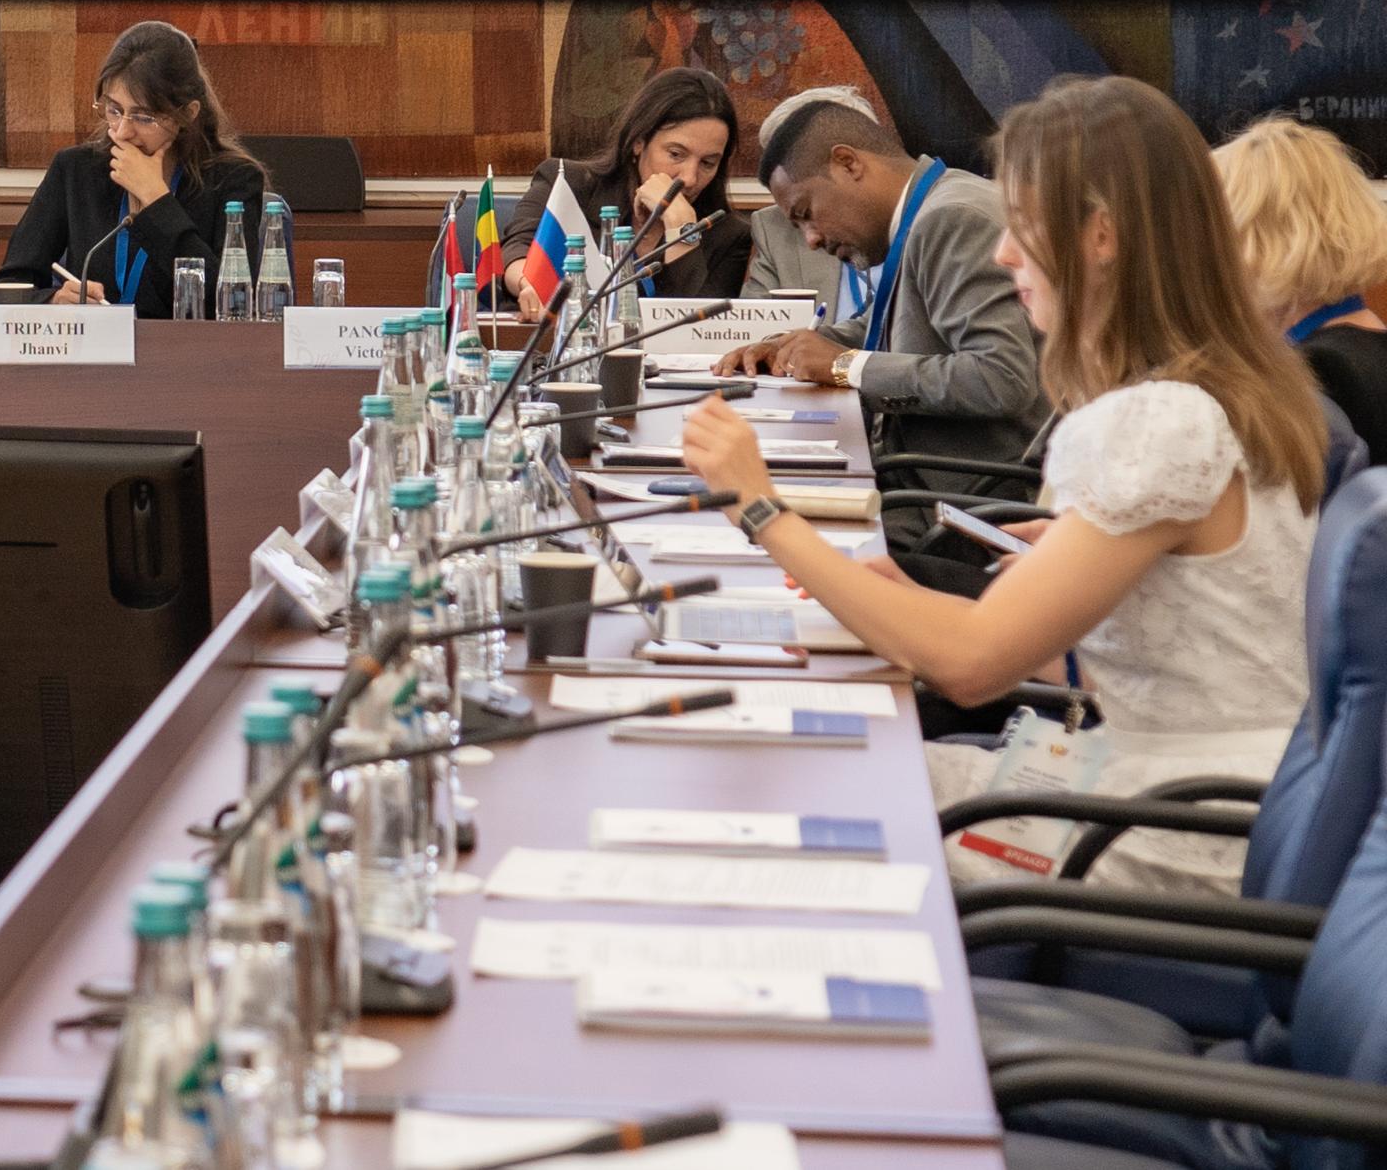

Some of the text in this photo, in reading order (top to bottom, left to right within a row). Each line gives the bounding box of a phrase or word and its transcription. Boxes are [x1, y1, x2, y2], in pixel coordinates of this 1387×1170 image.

[1, 321, 86, 336] TRIPATHI
[691, 327, 751, 341] Nandan
[19, 342, 69, 356] Jhanvi
